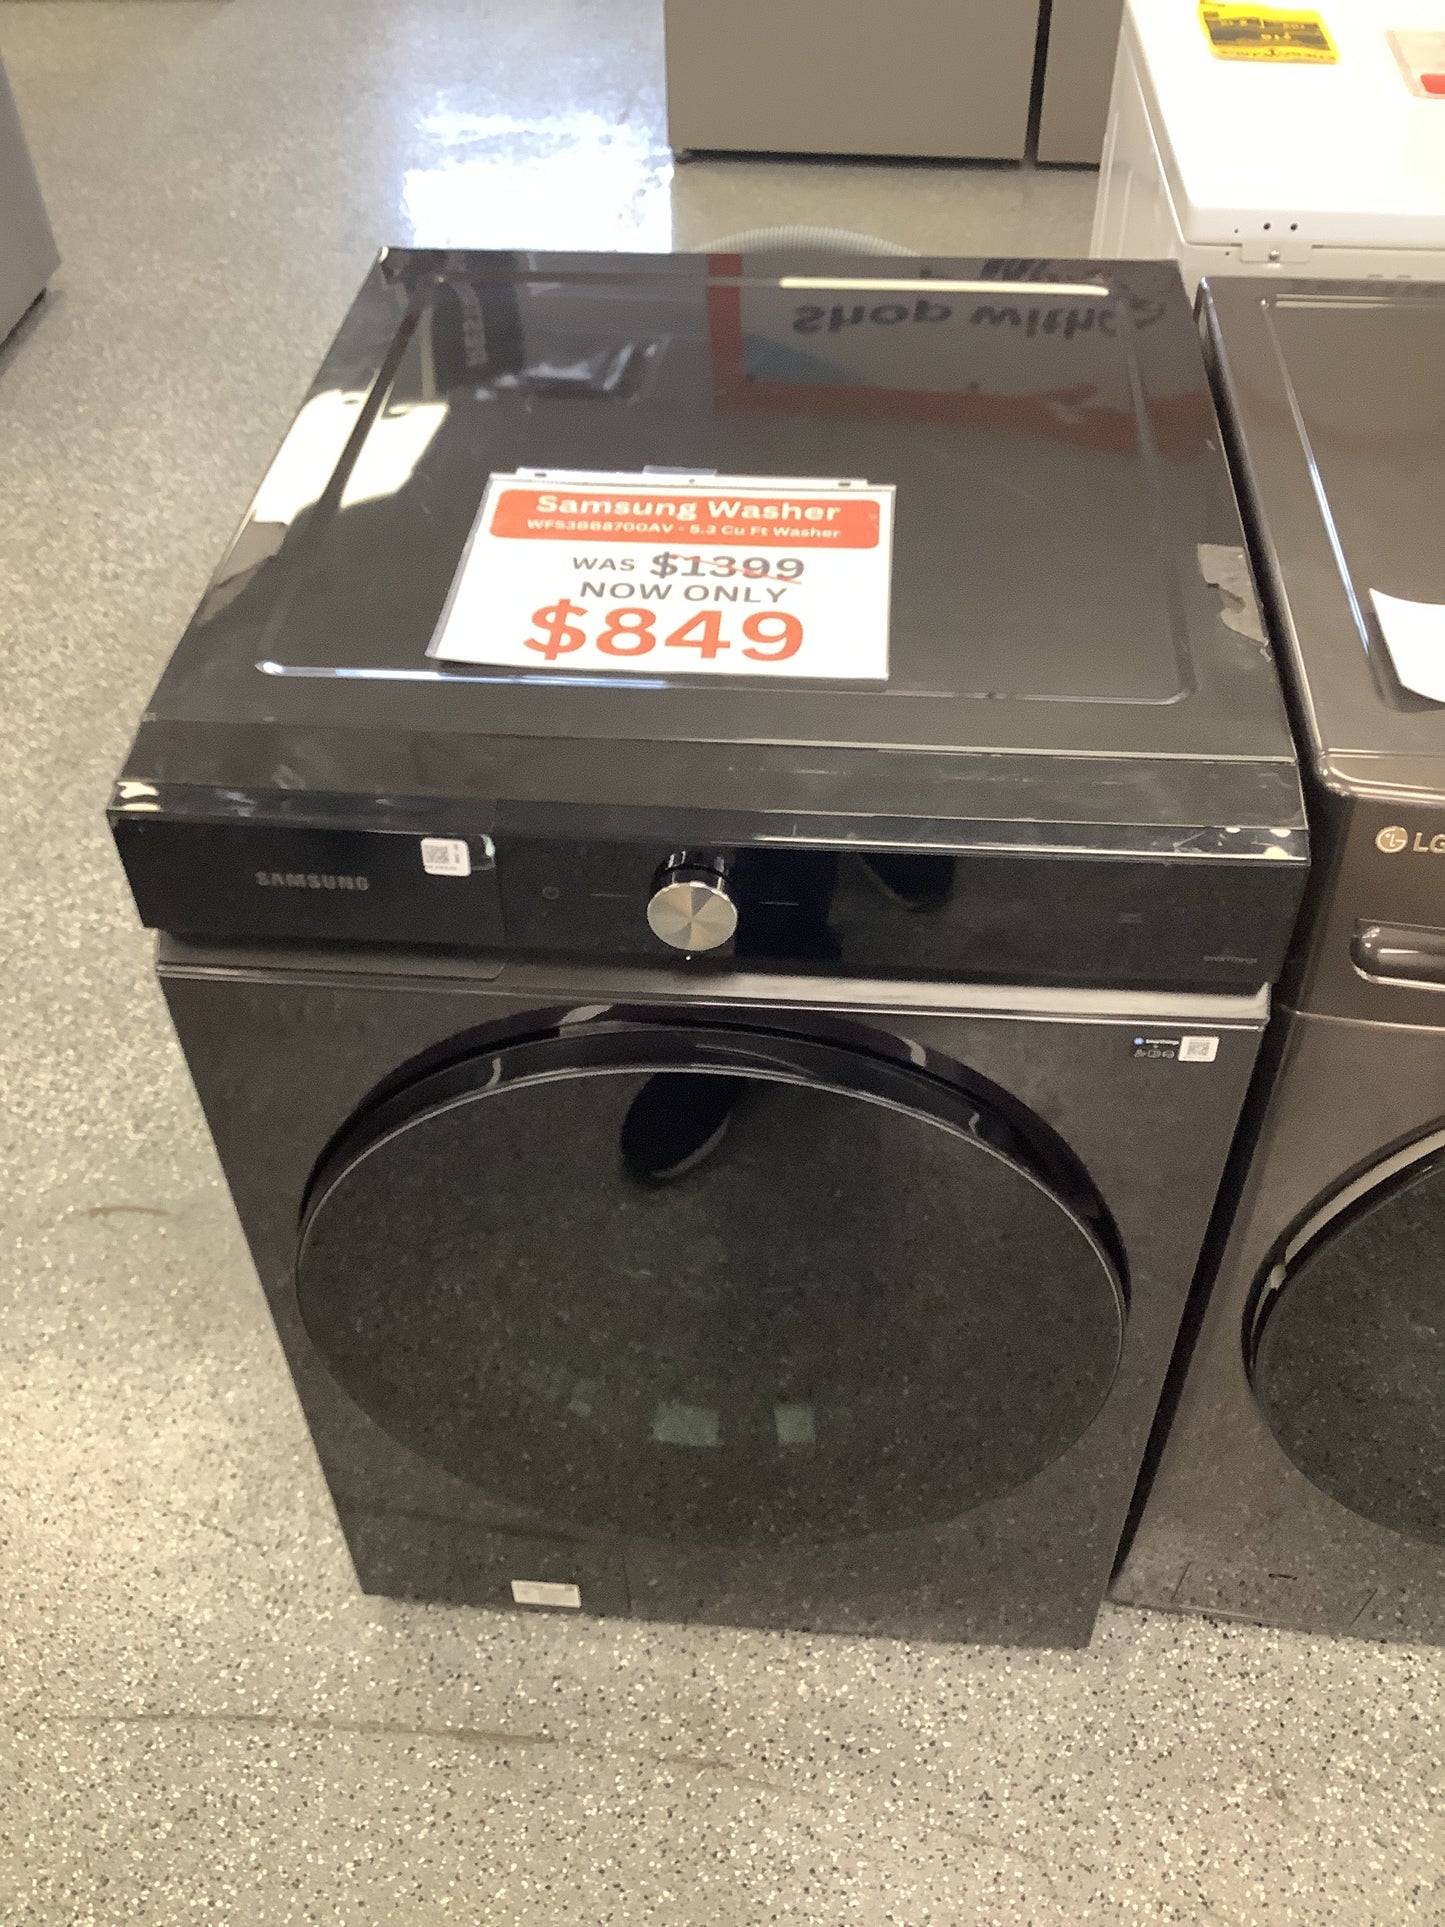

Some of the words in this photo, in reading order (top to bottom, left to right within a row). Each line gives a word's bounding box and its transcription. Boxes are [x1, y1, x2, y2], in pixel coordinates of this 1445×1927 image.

[535, 495, 697, 521] Samsung
[707, 500, 842, 522] Washer
[721, 525, 745, 536] Cu
[749, 526, 768, 536] Ft
[772, 527, 841, 539] Washer
[572, 557, 636, 572] WAS
[649, 551, 806, 582] $1399
[578, 581, 673, 600] NOW
[682, 584, 788, 604] ONLY
[523, 598, 804, 662] $849
[1412, 832, 1445, 854] LG
[255, 870, 370, 891] SAMSUNG
